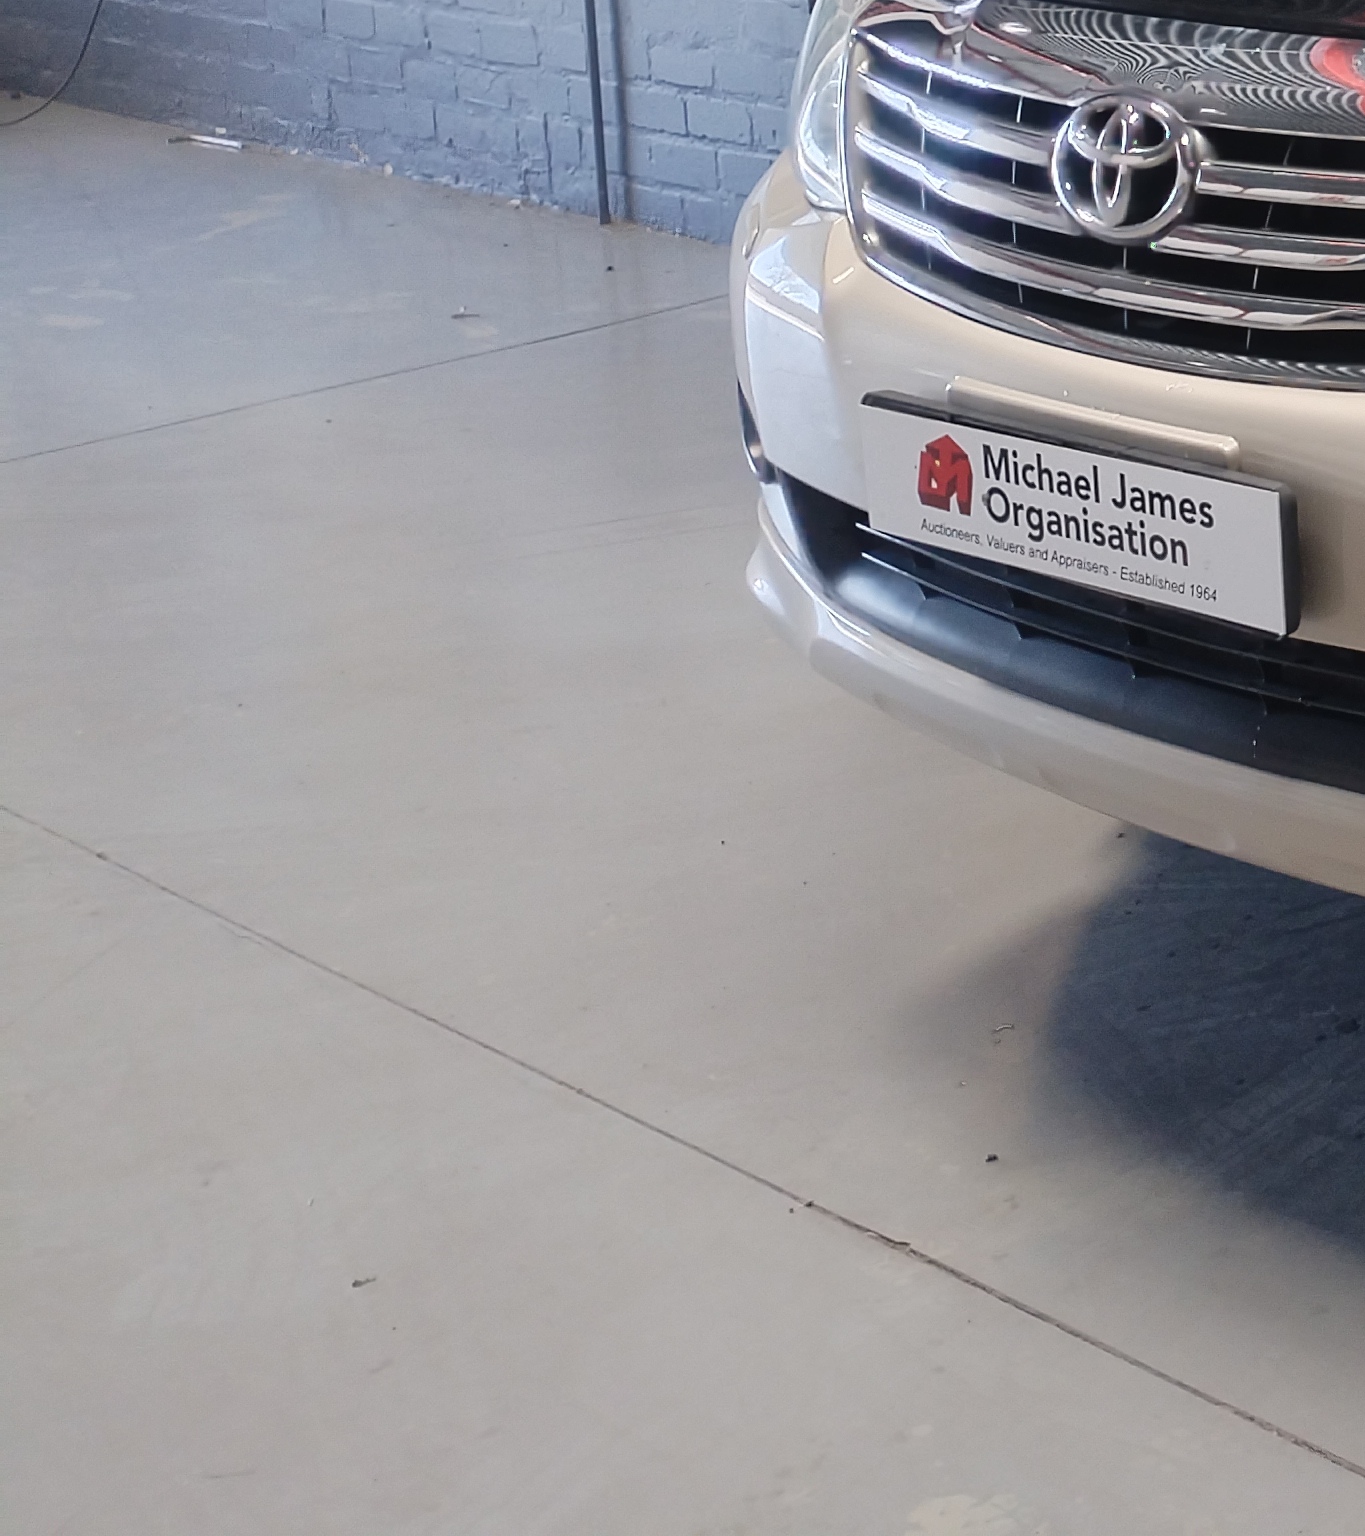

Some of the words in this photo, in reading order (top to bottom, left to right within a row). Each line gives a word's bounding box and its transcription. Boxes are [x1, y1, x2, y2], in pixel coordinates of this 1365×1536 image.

[982, 443, 1100, 504] Michael
[1112, 472, 1215, 529] James
[985, 487, 1190, 567] Organisation
[986, 534, 1026, 558] Valuers
[1028, 544, 1048, 562] and
[1051, 550, 1110, 579] Appraisers
[1120, 567, 1186, 595] Established
[1189, 582, 1218, 603] 1964
